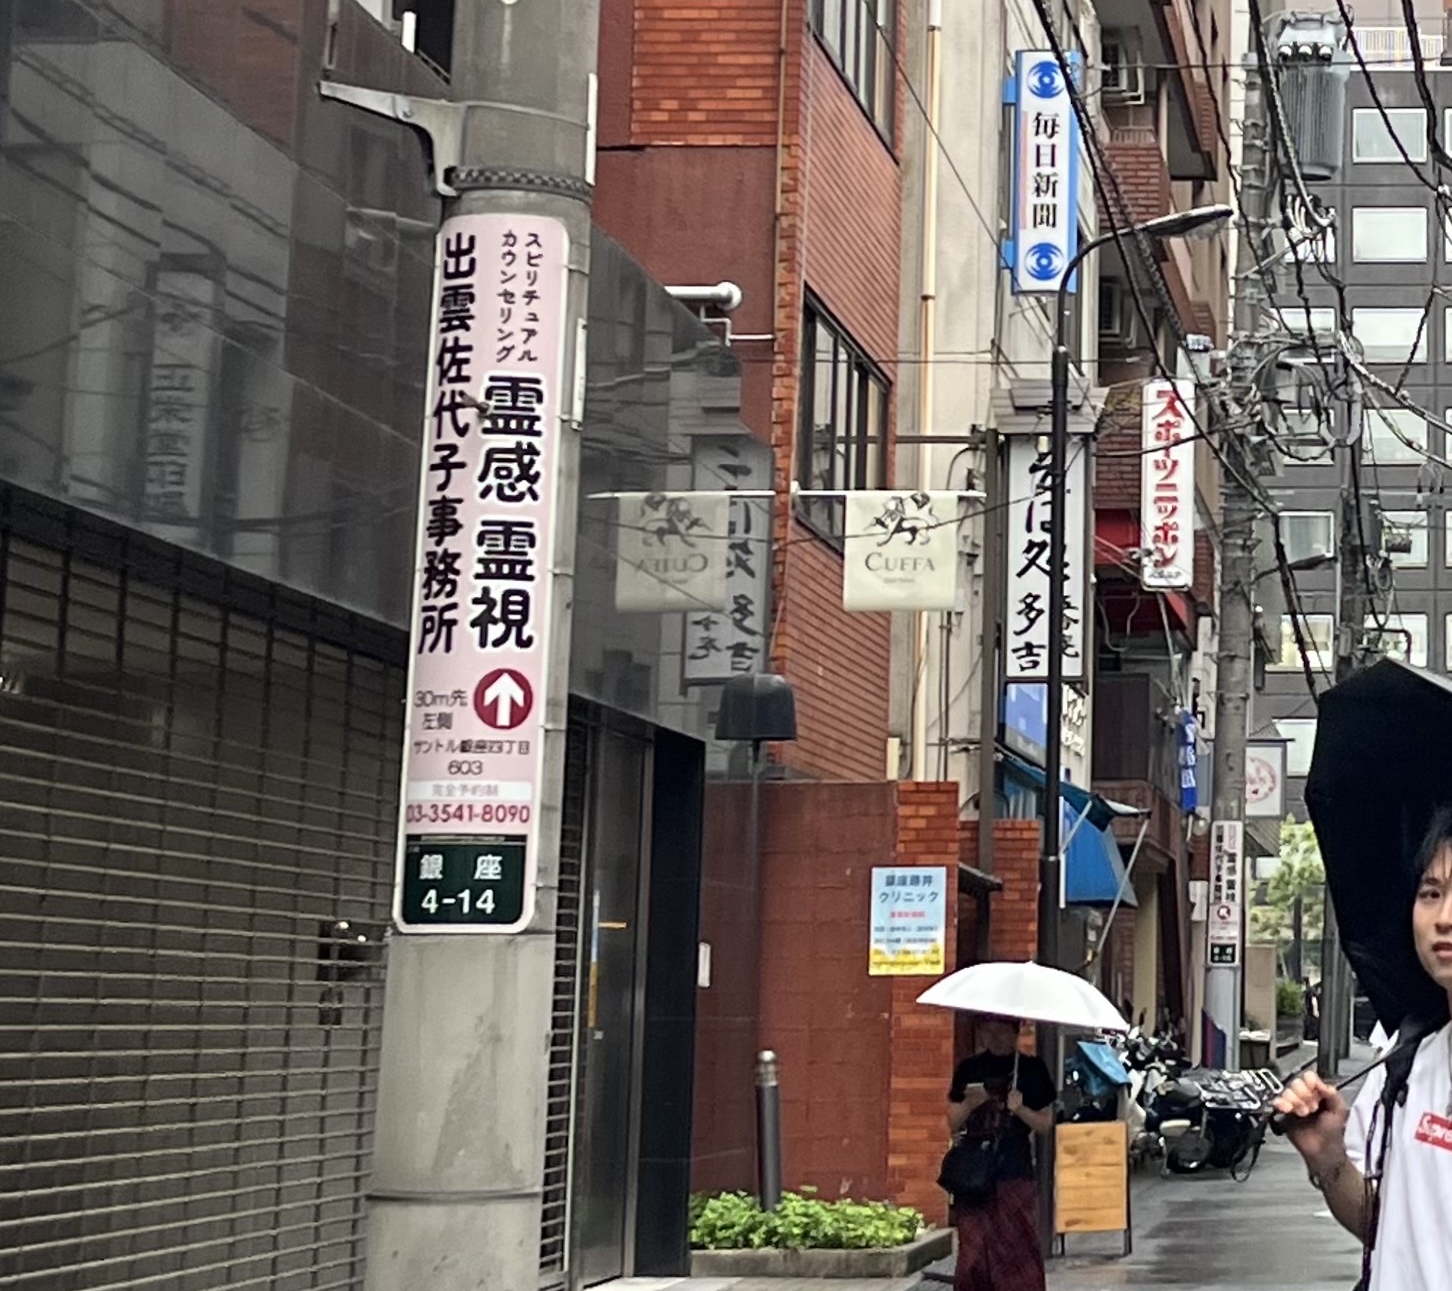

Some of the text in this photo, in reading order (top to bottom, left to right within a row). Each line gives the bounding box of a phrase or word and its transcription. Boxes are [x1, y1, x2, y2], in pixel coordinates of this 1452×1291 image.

[1032, 112, 1060, 229] 毎日新聞
[496, 229, 527, 363] カウンセリング
[518, 232, 543, 362] スピリチュアル
[418, 232, 476, 653] 出雲佐代子事務所
[1152, 389, 1184, 567] スポーツニッポン
[422, 712, 453, 730] 左側
[448, 760, 483, 775] 603
[406, 804, 530, 823] 03-3541-8090
[421, 889, 496, 914] 4-14
[879, 891, 939, 904] クリニック
